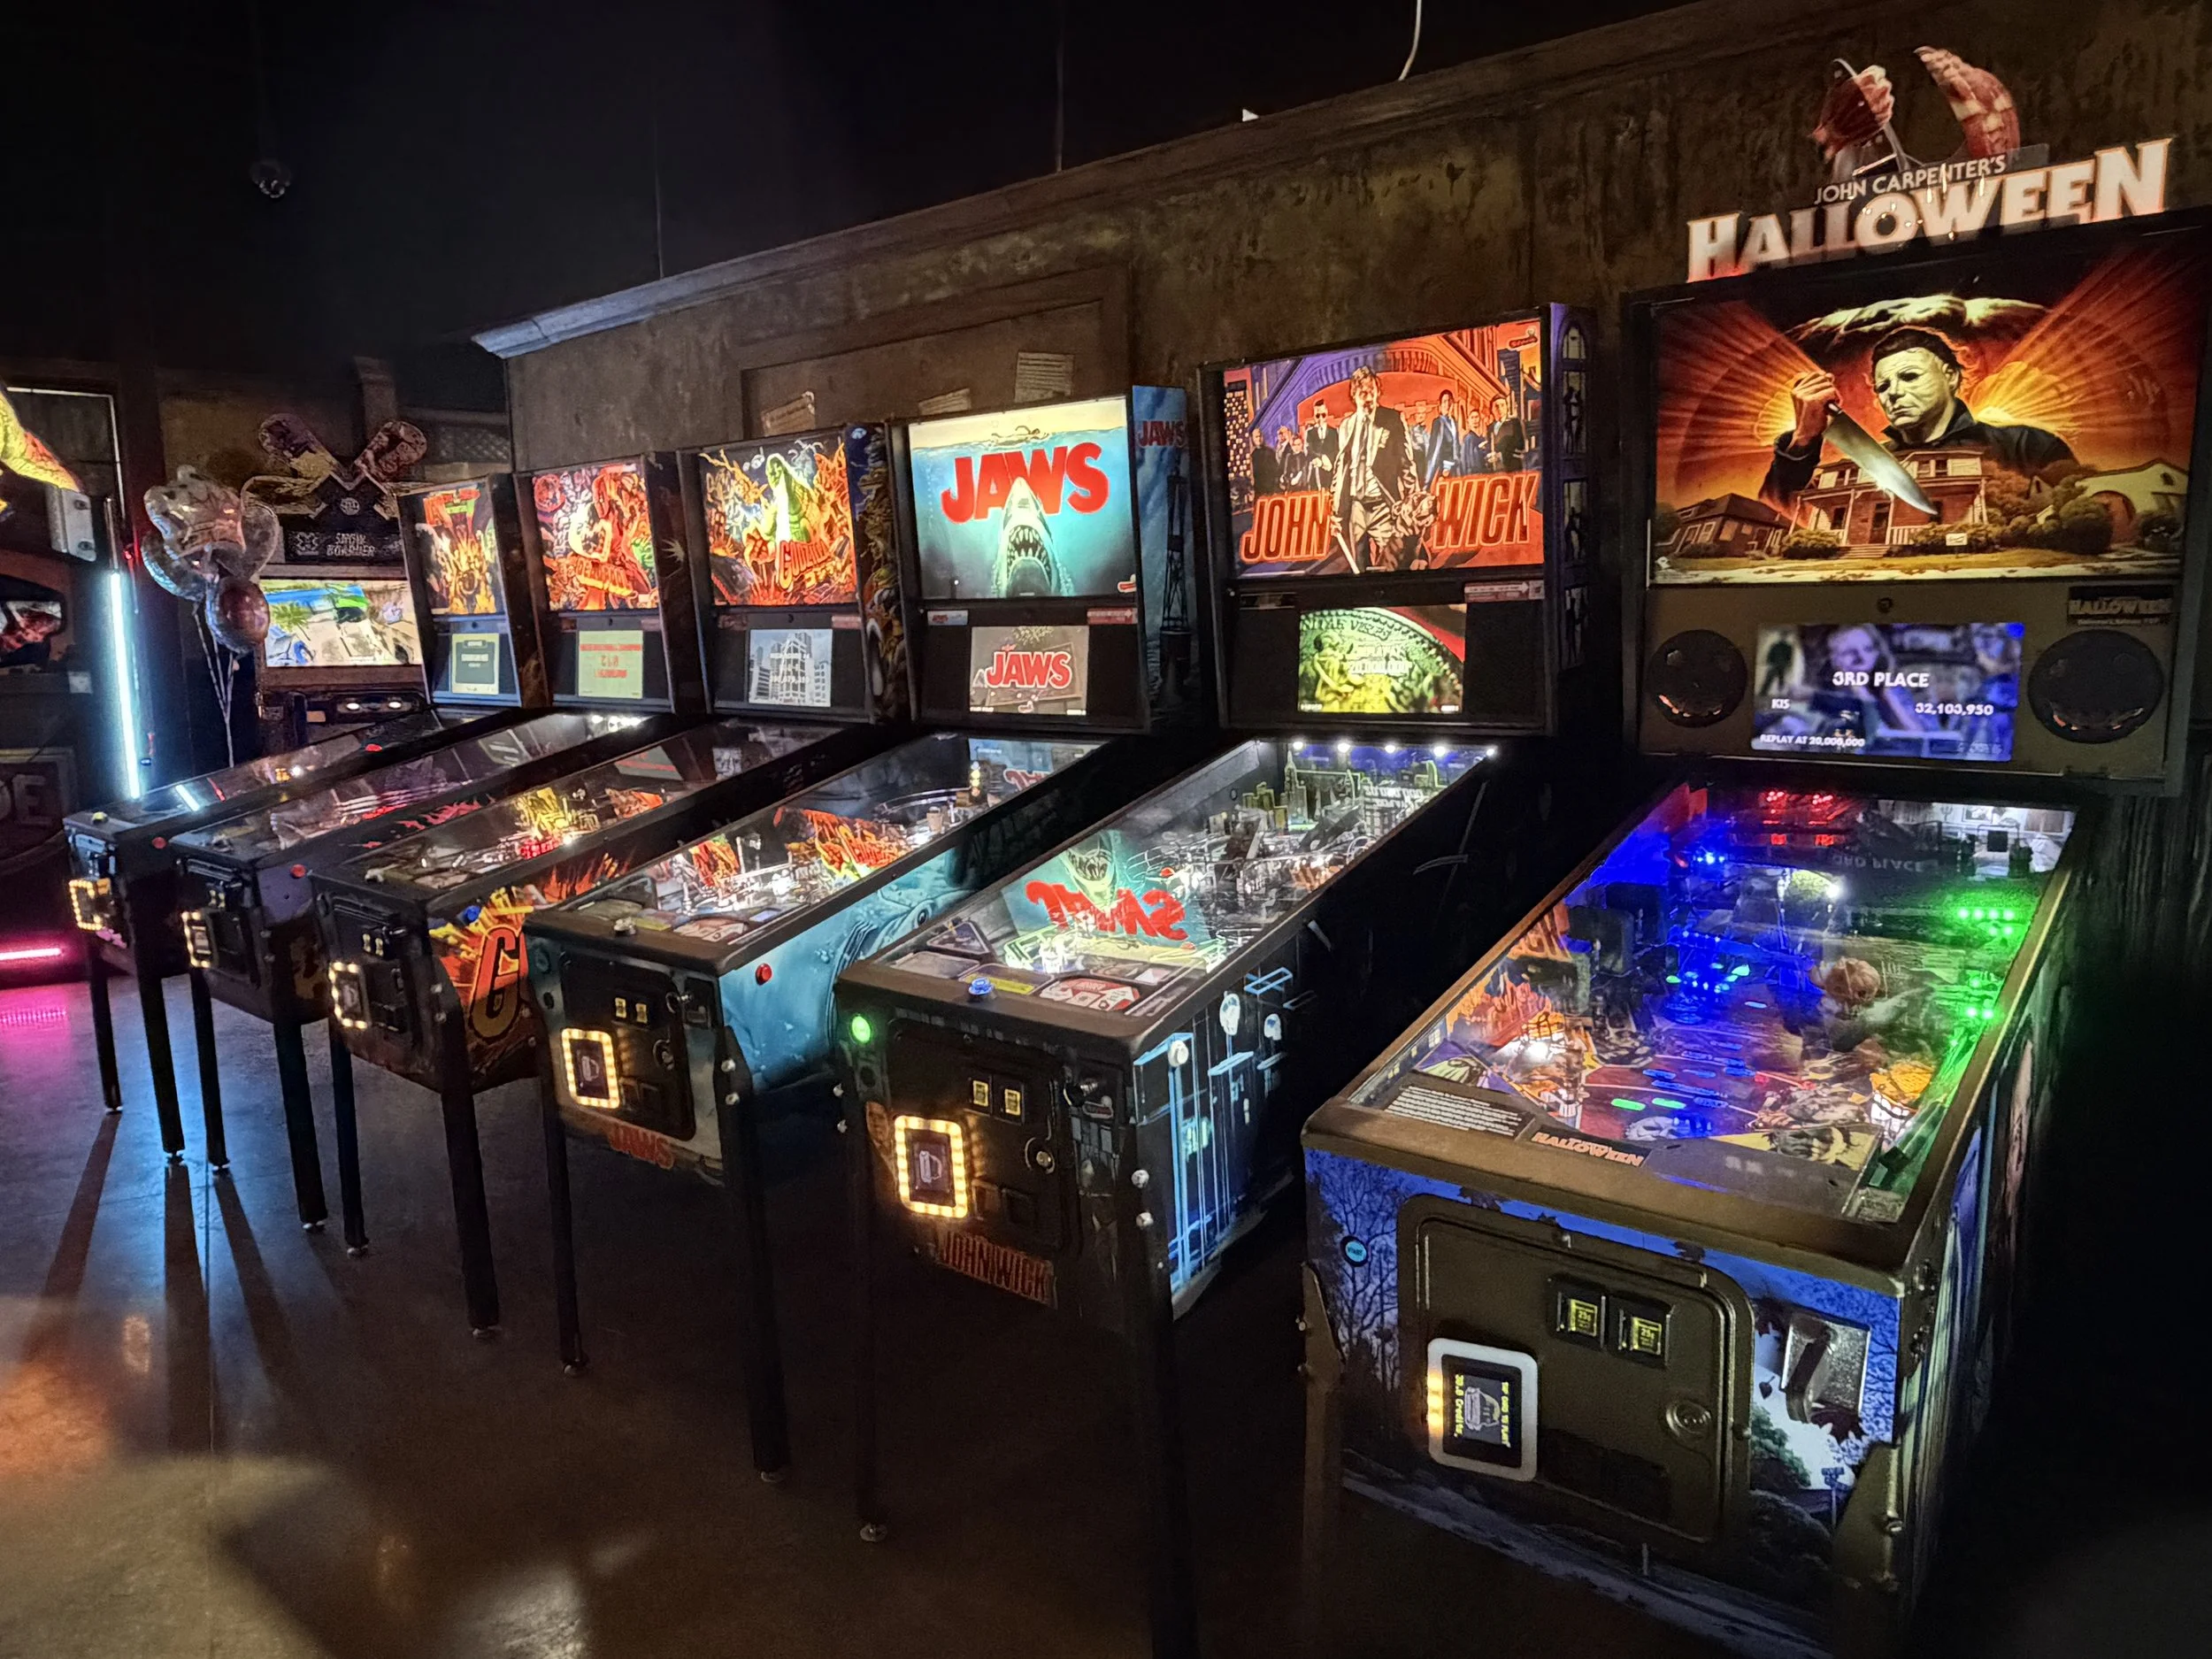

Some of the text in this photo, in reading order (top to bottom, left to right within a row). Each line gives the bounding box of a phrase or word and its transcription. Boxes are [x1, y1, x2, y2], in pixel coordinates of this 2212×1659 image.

[1813, 154, 2007, 206] JOHN CARPENTER'S
[1686, 136, 2173, 284] HALLOWEEN
[1136, 419, 1187, 449] JAWS
[941, 442, 1110, 525] JAWS
[1240, 472, 1540, 564] JOHN WICK
[985, 650, 1072, 688] JAWS
[1832, 671, 1931, 688] 3RD PLACE
[1759, 733, 1866, 748] REPLAY AT 20,000,000
[609, 1122, 675, 1170] JAWS
[1531, 1131, 1645, 1167] HALLOWEEN
